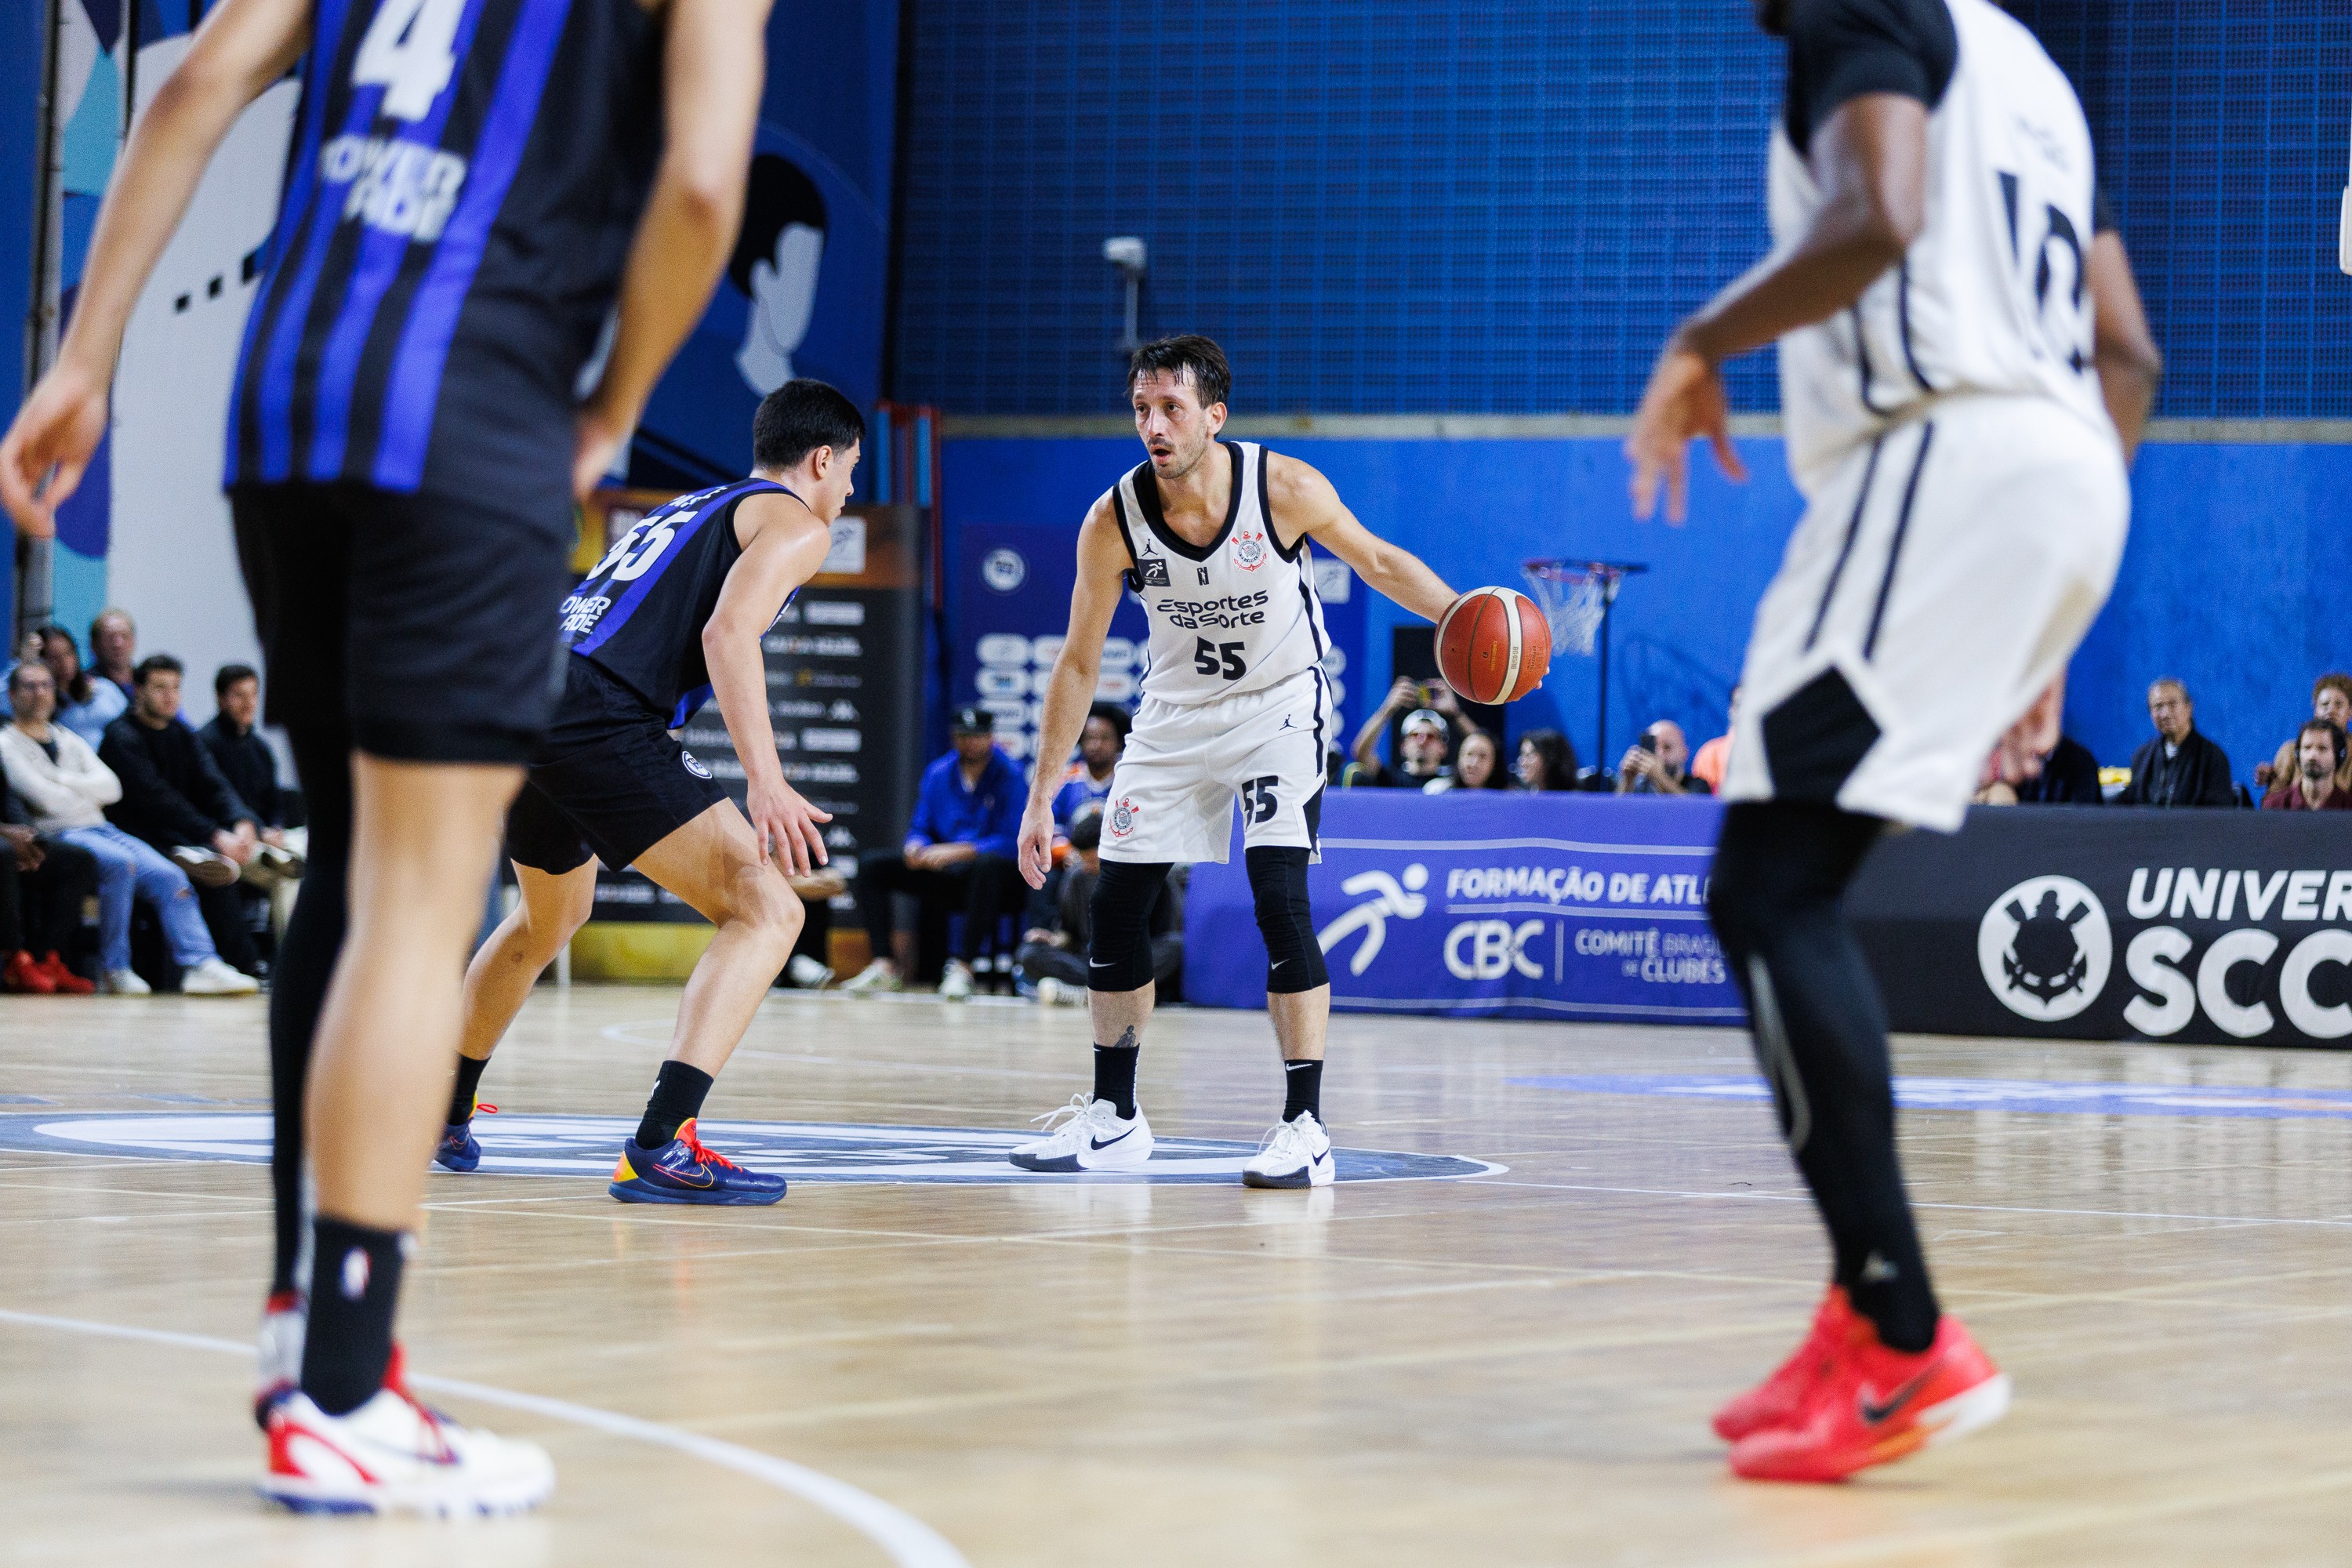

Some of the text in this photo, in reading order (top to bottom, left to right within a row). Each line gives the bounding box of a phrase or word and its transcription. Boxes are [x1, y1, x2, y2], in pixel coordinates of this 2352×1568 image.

[353, 0, 464, 122] 4
[320, 133, 467, 207] OWER
[586, 510, 699, 581] 55
[559, 596, 612, 616] OWER
[1156, 590, 1269, 617] Esportes
[1194, 636, 1247, 681] 55
[1241, 775, 1279, 829] 55
[1446, 866, 1711, 906] FORMAÇÃO DE ATL
[2127, 867, 2352, 921] UNIVER
[1443, 919, 1545, 981] CBC
[1574, 927, 1660, 958] COMITÊ
